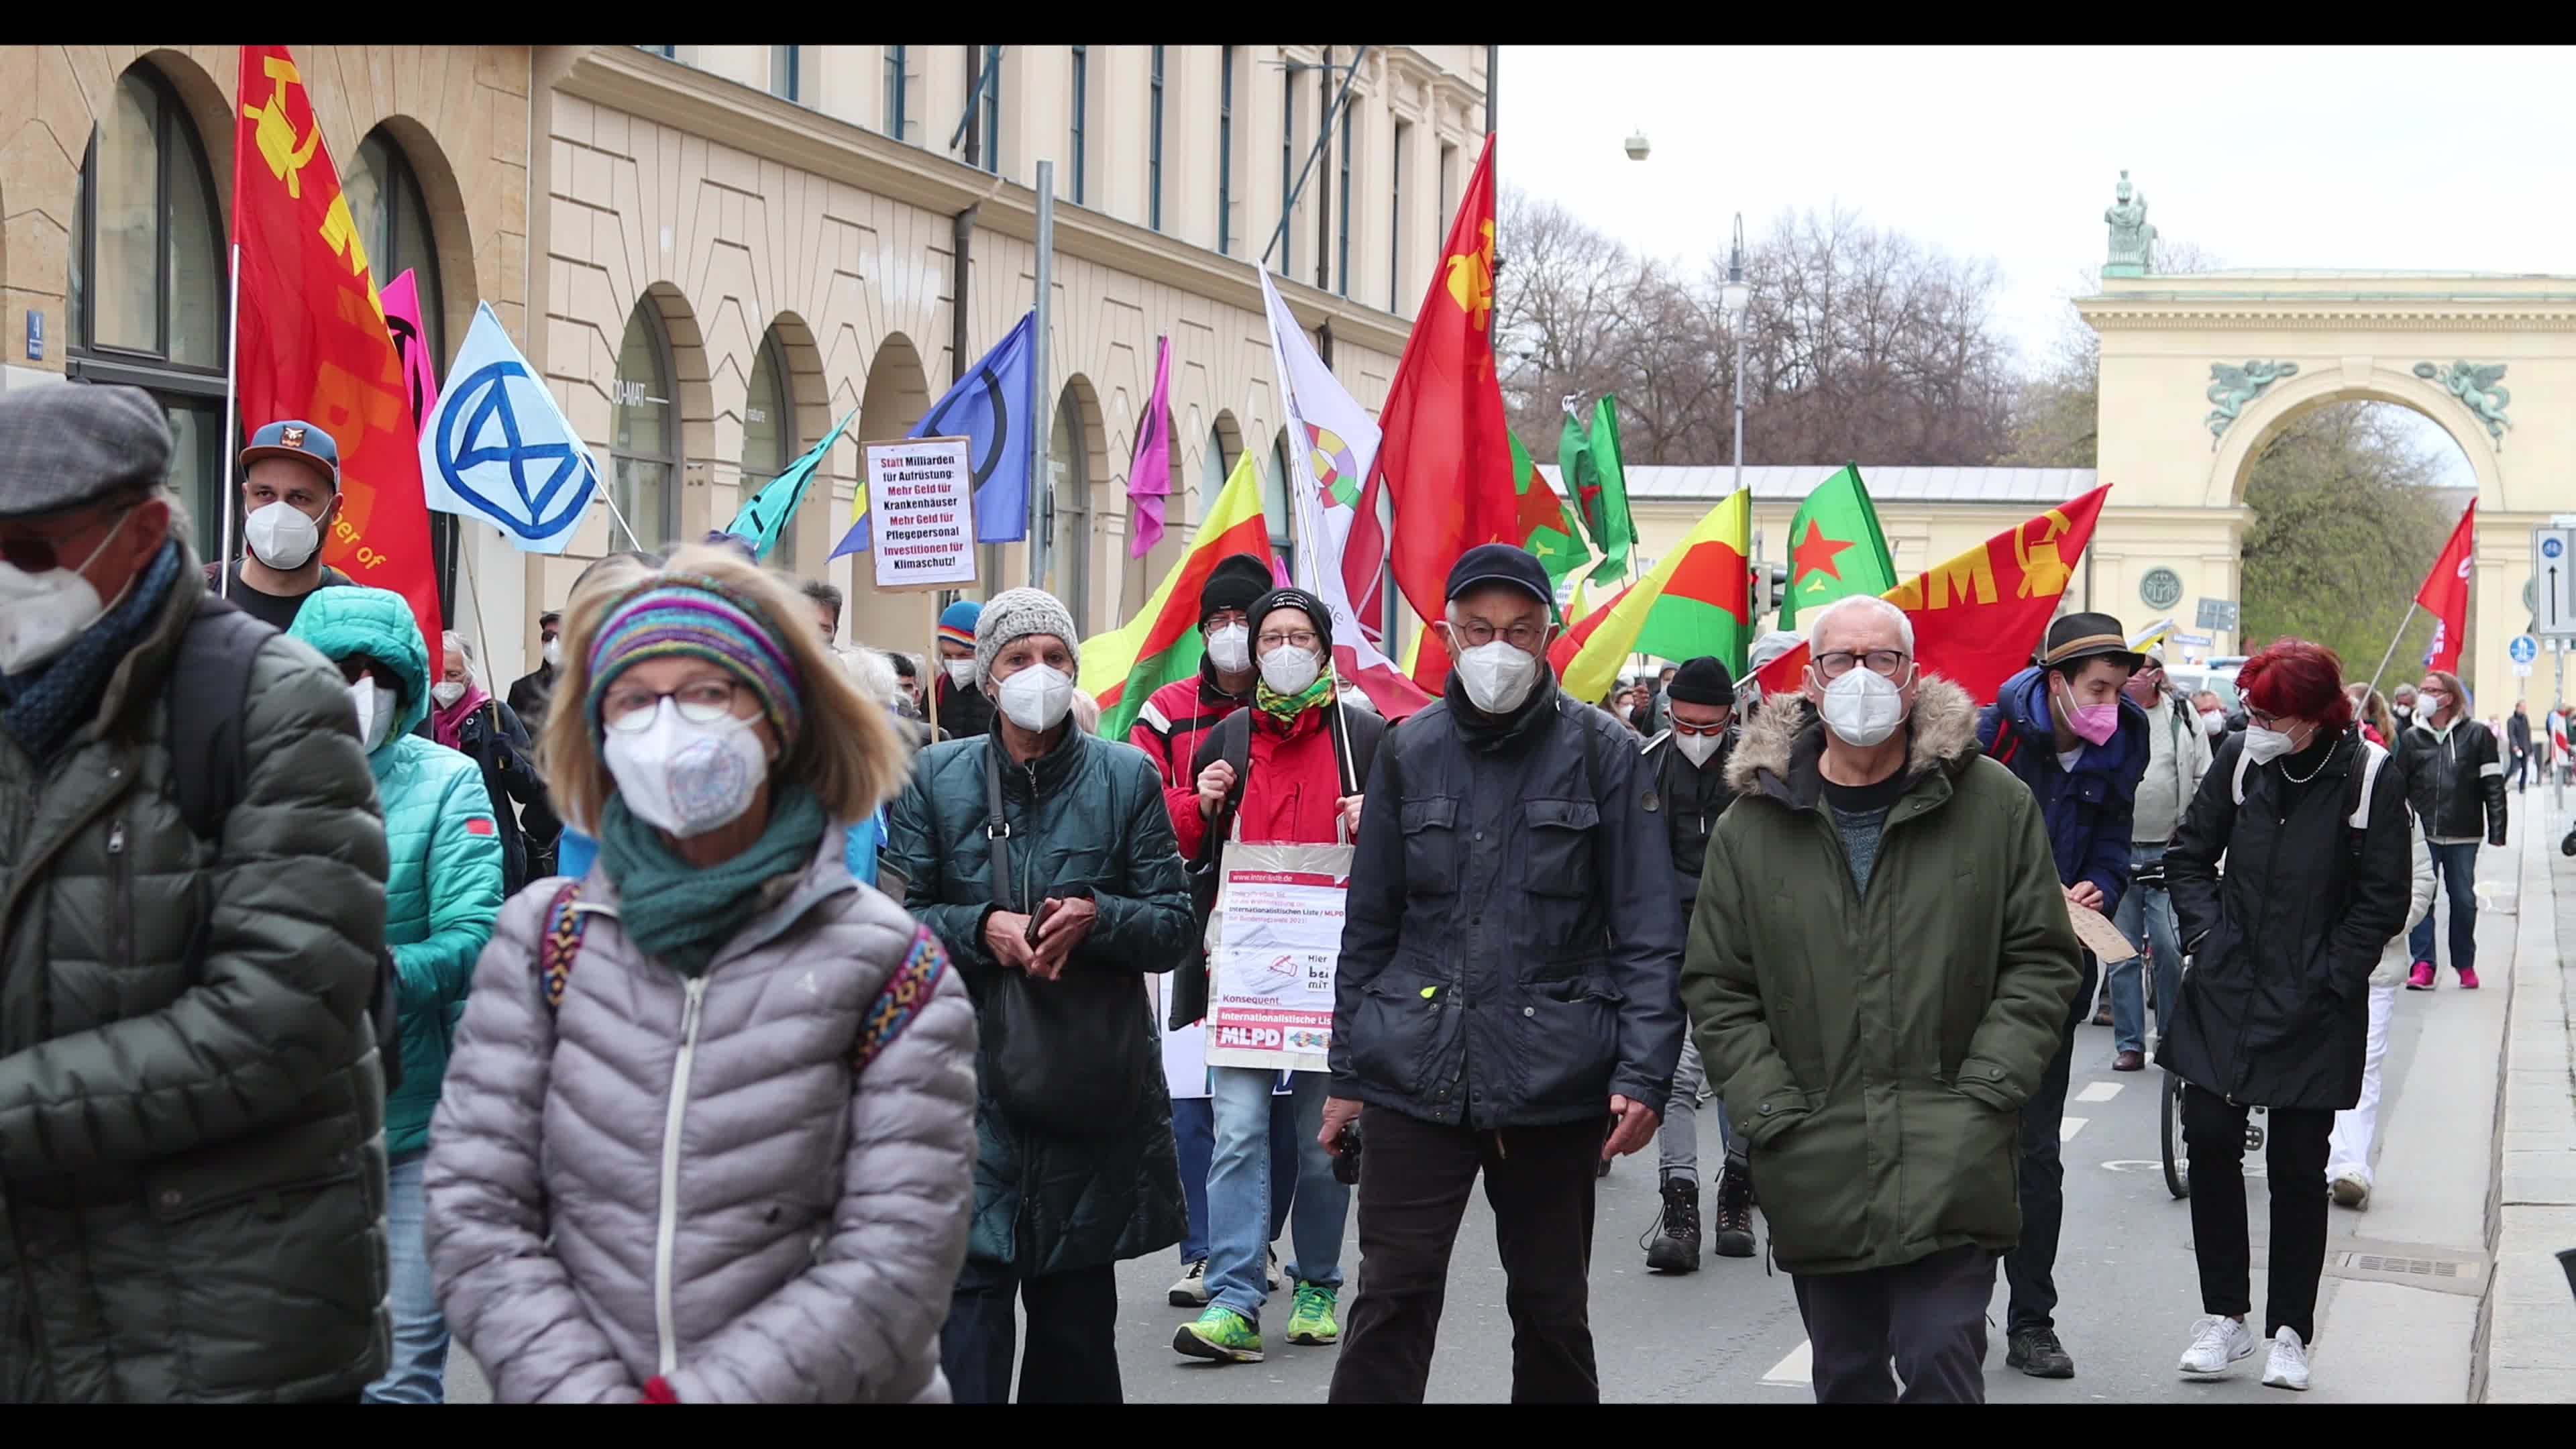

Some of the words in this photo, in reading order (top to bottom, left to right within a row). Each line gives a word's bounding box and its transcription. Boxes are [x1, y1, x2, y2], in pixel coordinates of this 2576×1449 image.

[881, 458, 903, 468] Statt
[906, 455, 955, 466] Milliarden
[883, 473, 896, 482] für
[899, 470, 954, 481] Aufrüstung:
[888, 486, 912, 496] Mehr
[915, 484, 935, 494] Geld
[938, 484, 952, 493] für
[884, 497, 958, 511] Krankenhäuser
[890, 516, 914, 526] Mehr
[916, 514, 938, 524] Geld
[940, 513, 954, 523] für
[886, 526, 959, 541] Pflegepersonal
[884, 543, 949, 556] Investitionen
[950, 542, 964, 551] für
[356, 546, 387, 569] of
[894, 557, 956, 570] Klimaschutz!
[1308, 955, 1328, 963] Hier
[1309, 966, 1329, 979] bei
[1221, 1012, 1316, 1024] Internationalistische
[1220, 1026, 1281, 1046] MLPD
